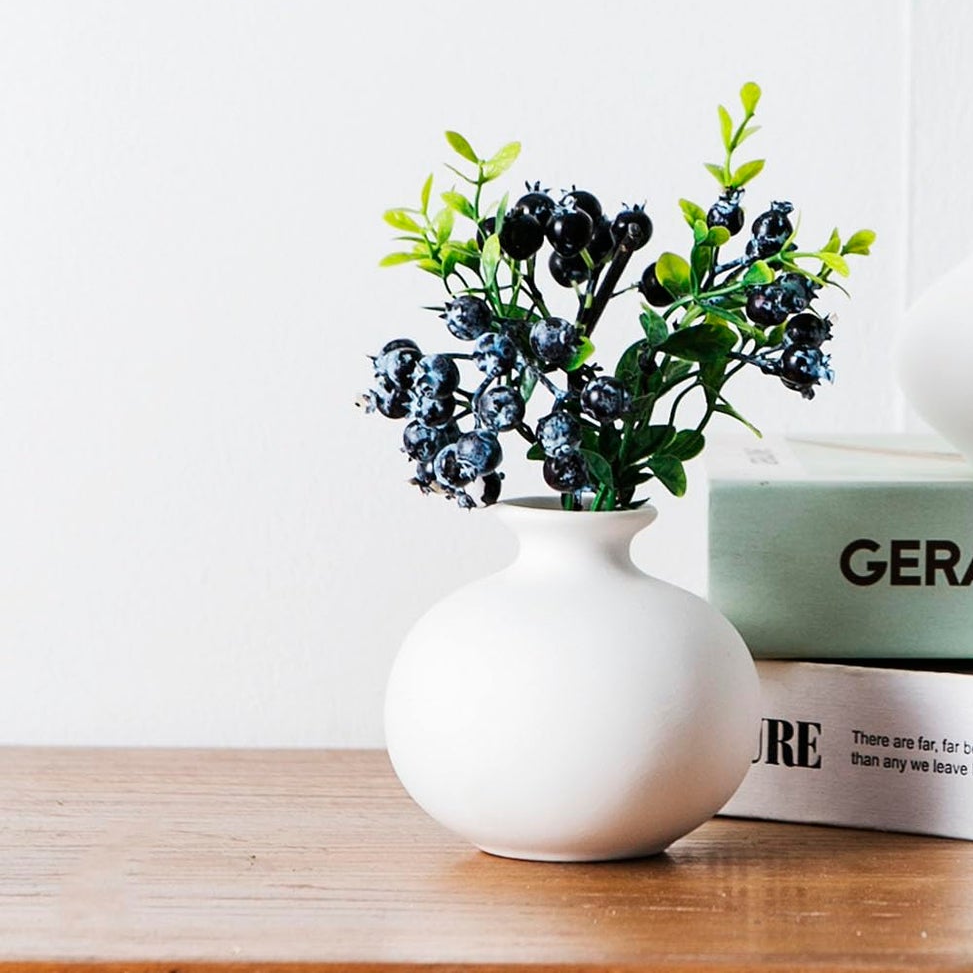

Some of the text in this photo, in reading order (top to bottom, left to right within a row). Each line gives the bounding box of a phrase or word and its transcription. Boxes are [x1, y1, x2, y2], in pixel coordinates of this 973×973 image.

[852, 730, 890, 747] There
[893, 737, 915, 749] are
[918, 736, 938, 753] far,
[942, 739, 959, 753] far
[851, 752, 880, 767] than
[883, 757, 907, 773] any
[911, 760, 929, 772] we
[933, 759, 968, 775] leave
